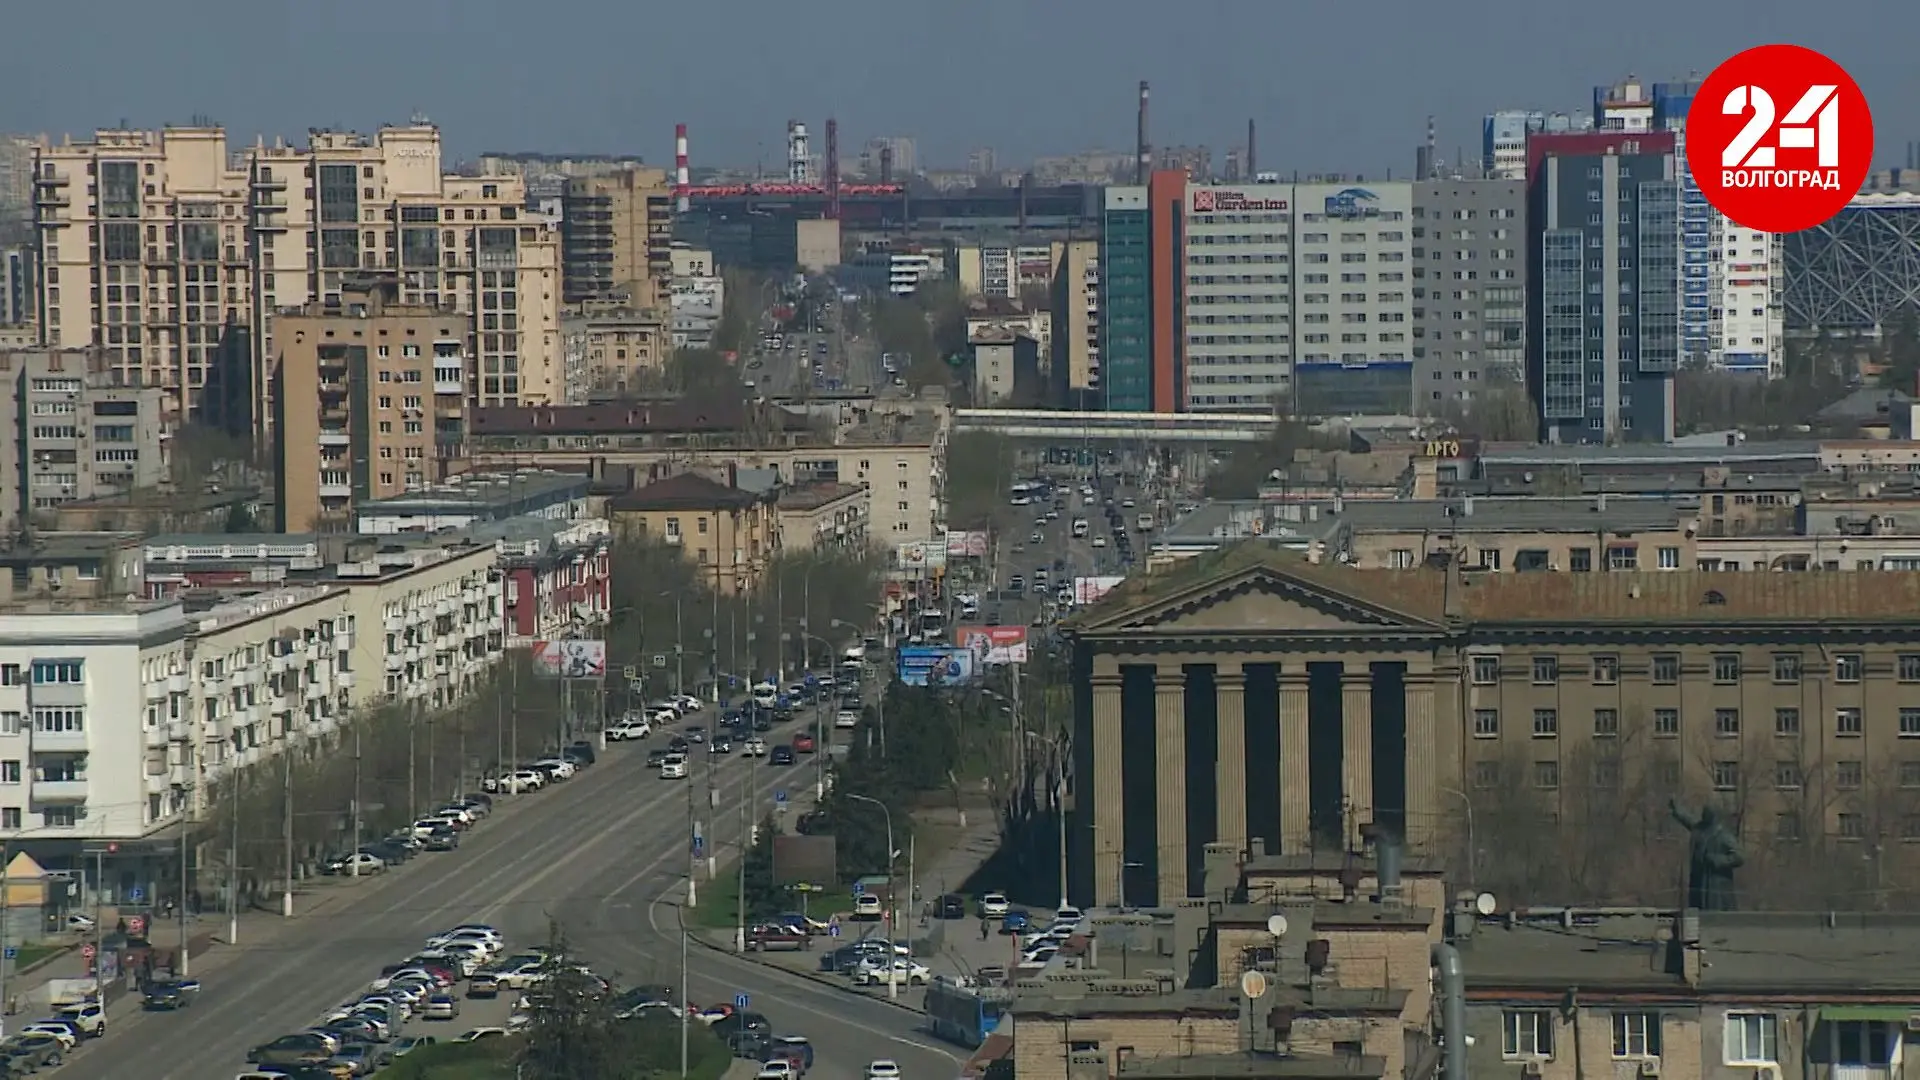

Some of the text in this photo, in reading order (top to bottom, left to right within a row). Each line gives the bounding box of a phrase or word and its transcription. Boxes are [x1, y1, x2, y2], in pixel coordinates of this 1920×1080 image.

[1215, 198, 1287, 210] Garden Inn
[1426, 441, 1459, 456] АРГО
